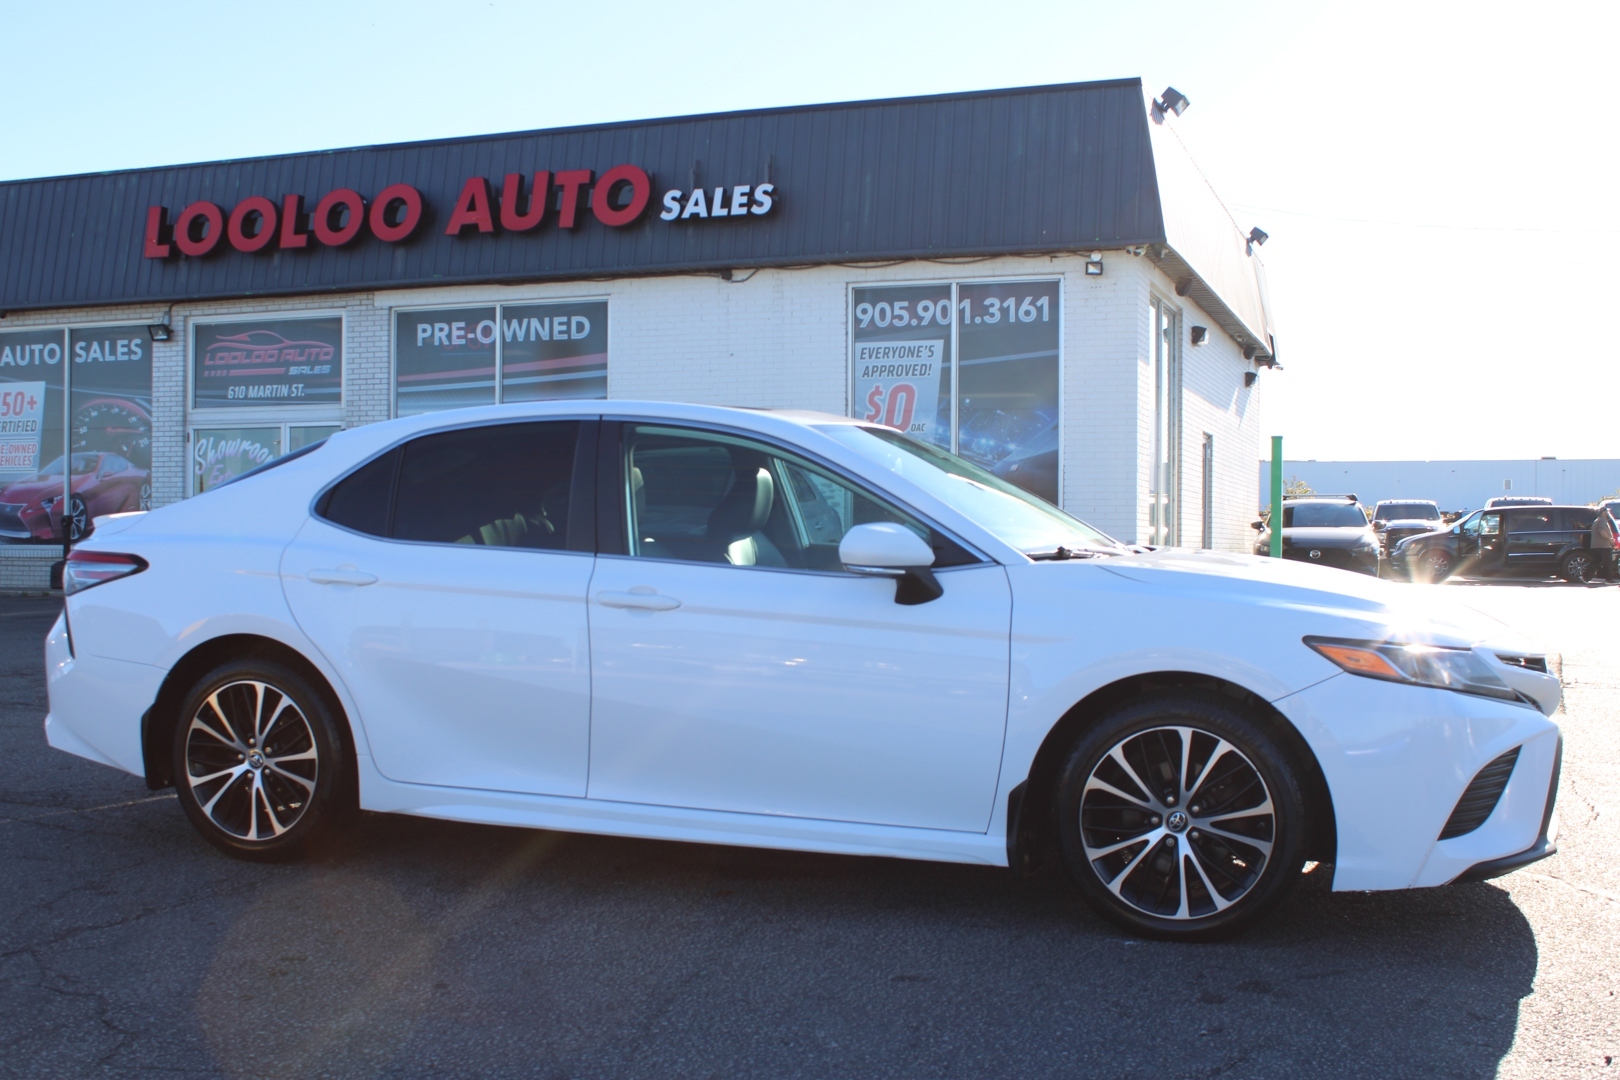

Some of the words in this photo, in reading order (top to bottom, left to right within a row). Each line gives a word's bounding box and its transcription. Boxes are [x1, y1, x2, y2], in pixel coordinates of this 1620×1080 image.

[144, 183, 423, 258] LOOLOO
[444, 164, 651, 235] AUTO
[659, 183, 774, 221] SALES
[855, 296, 1050, 328] 905.901.3161
[417, 315, 591, 346] PRE-OWNED
[0, 343, 61, 367] AUTO
[75, 338, 143, 363] SALES
[204, 350, 279, 365] LOOLOO
[280, 347, 335, 363] AUTO
[859, 344, 936, 361] EVERYONE'S
[288, 365, 332, 375] SALES
[862, 363, 932, 379] APPROVED!
[227, 386, 246, 399] 610
[248, 384, 289, 398] MARTIN
[291, 384, 305, 397] ST.
[910, 423, 926, 432] OAC
